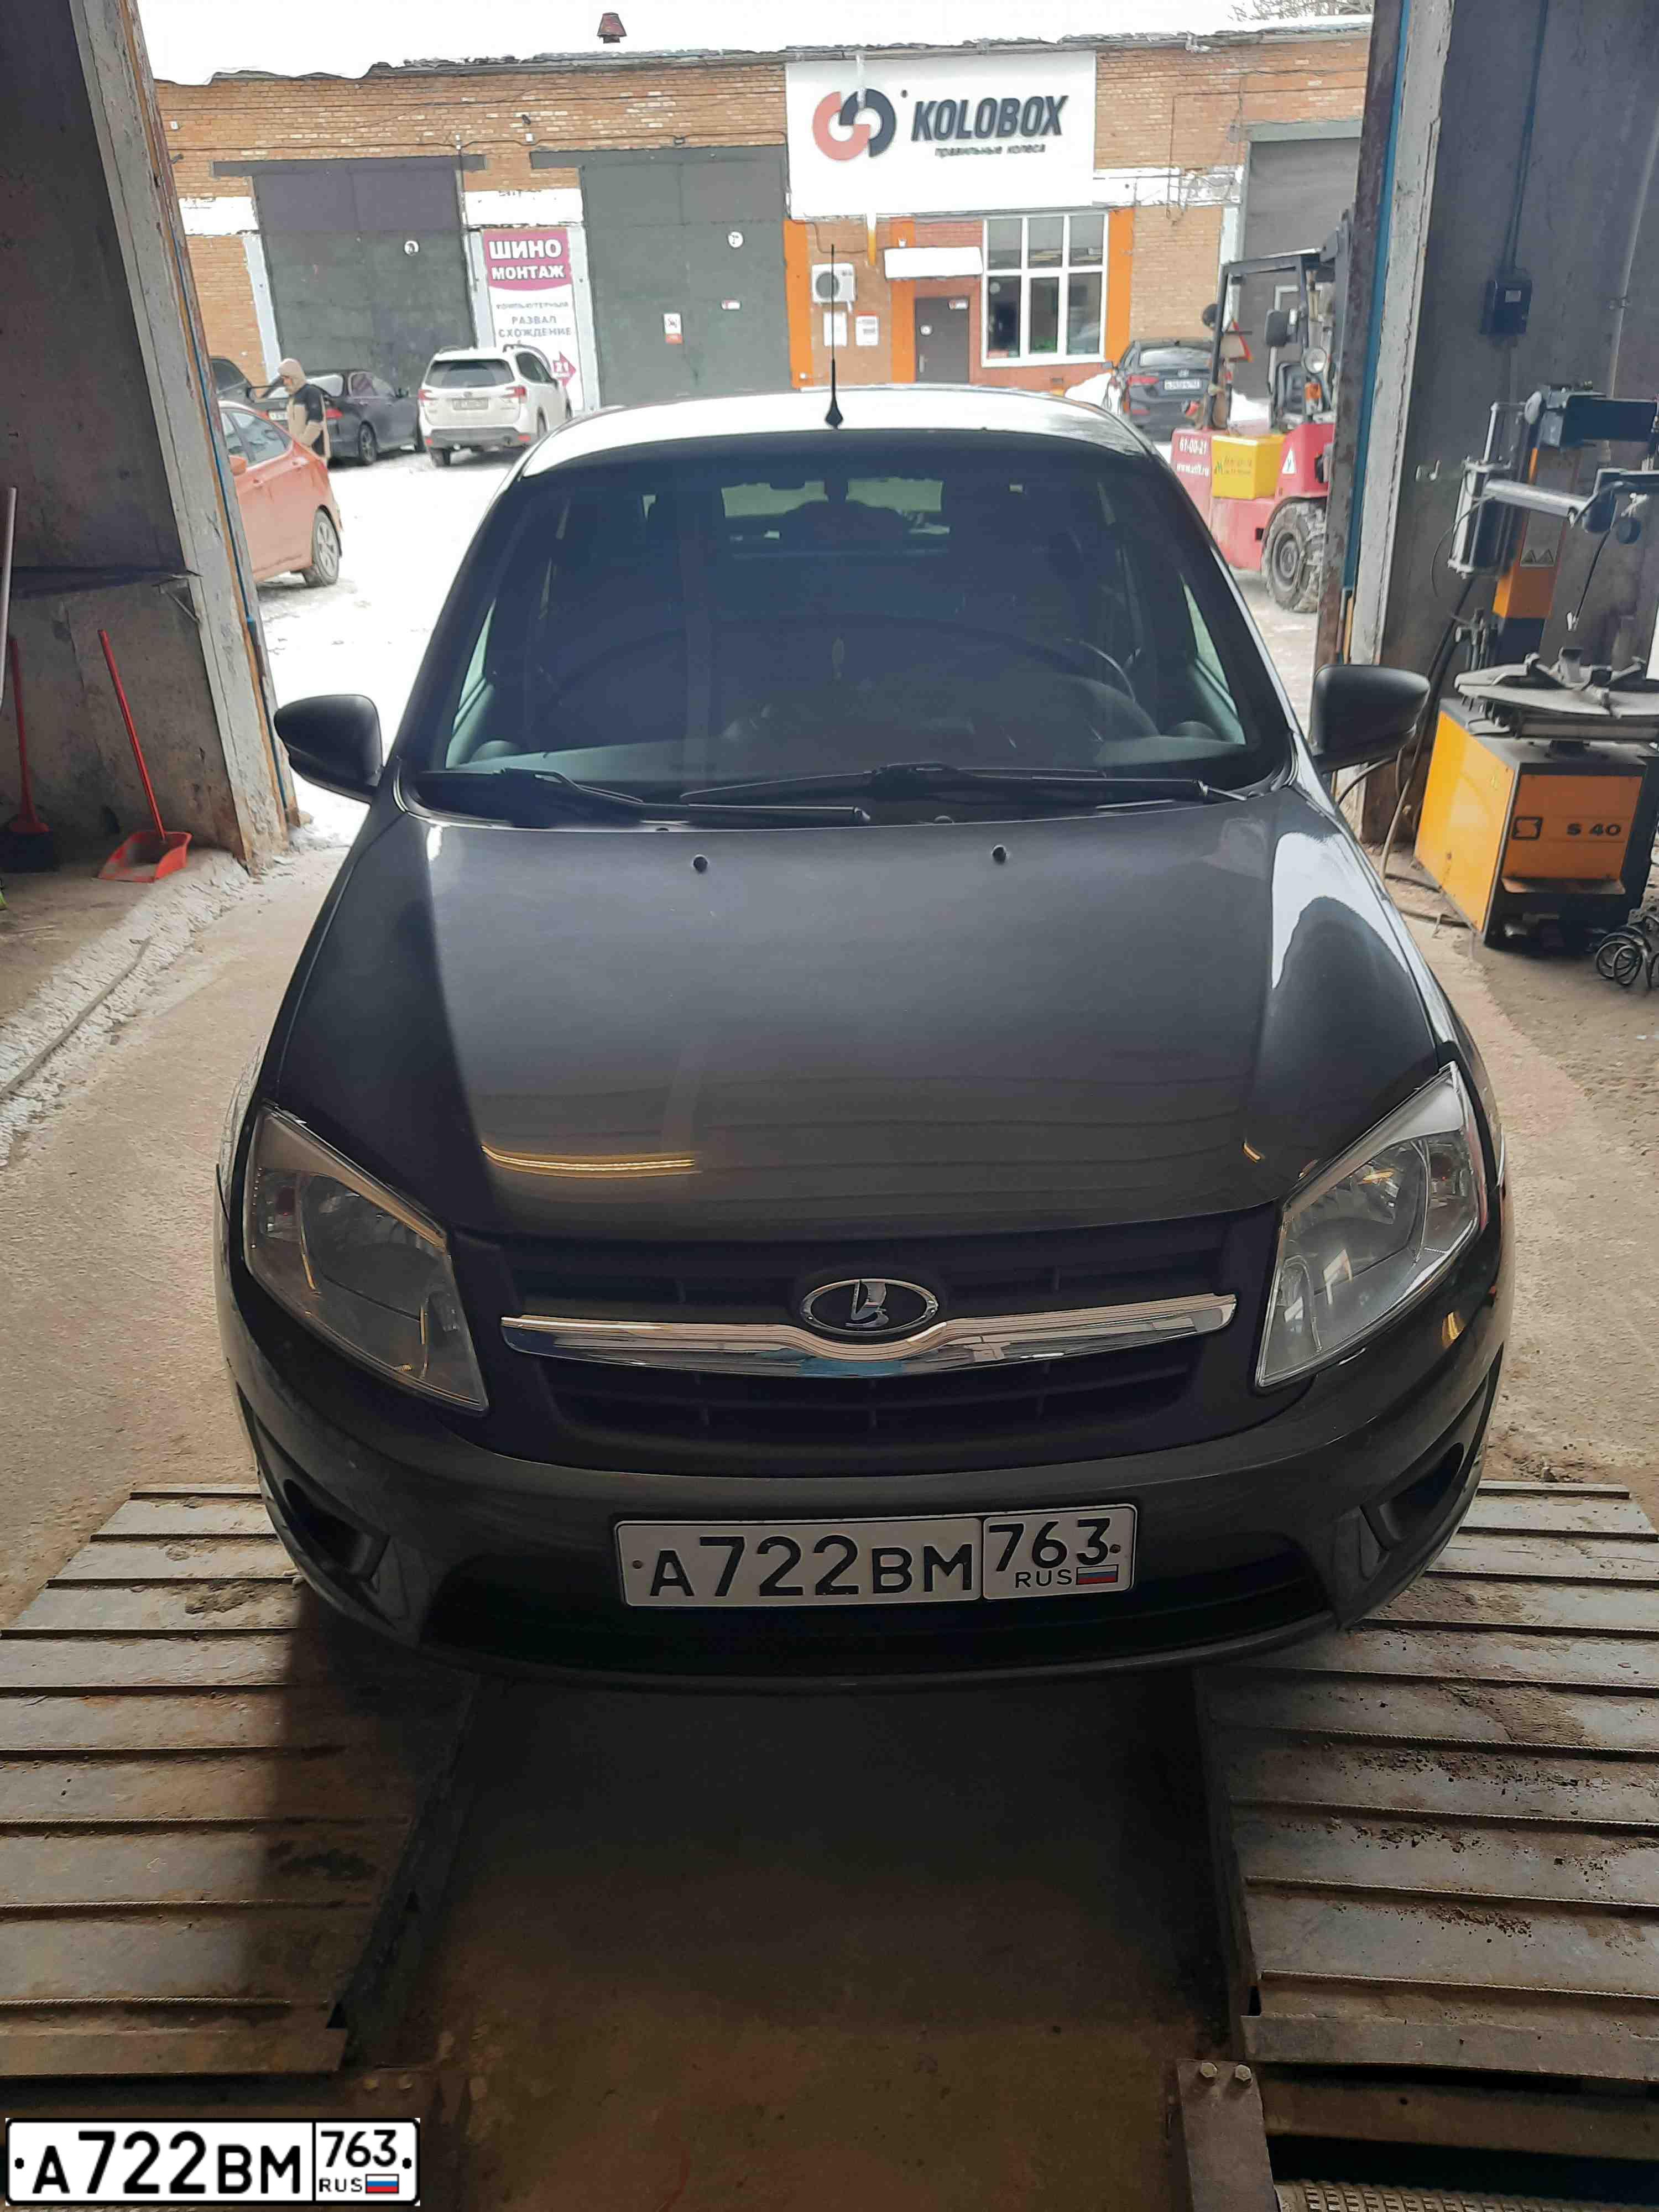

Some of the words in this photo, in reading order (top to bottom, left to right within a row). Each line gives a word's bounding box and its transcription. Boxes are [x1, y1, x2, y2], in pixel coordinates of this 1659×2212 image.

[911, 95, 1069, 142] KOLOBOX
[935, 146, 1002, 158] правильные
[1007, 144, 1046, 154] колеса
[488, 239, 562, 259] ШИНО
[491, 265, 566, 280] МОНТАЖ
[512, 316, 557, 325] РАЗВАЛ
[498, 327, 571, 338] СХОЖДЕНИЕ
[1567, 823, 1582, 836] S
[1589, 823, 1622, 836] 40
[989, 1518, 1111, 1572] 763
[1015, 1569, 1072, 1588] RUS
